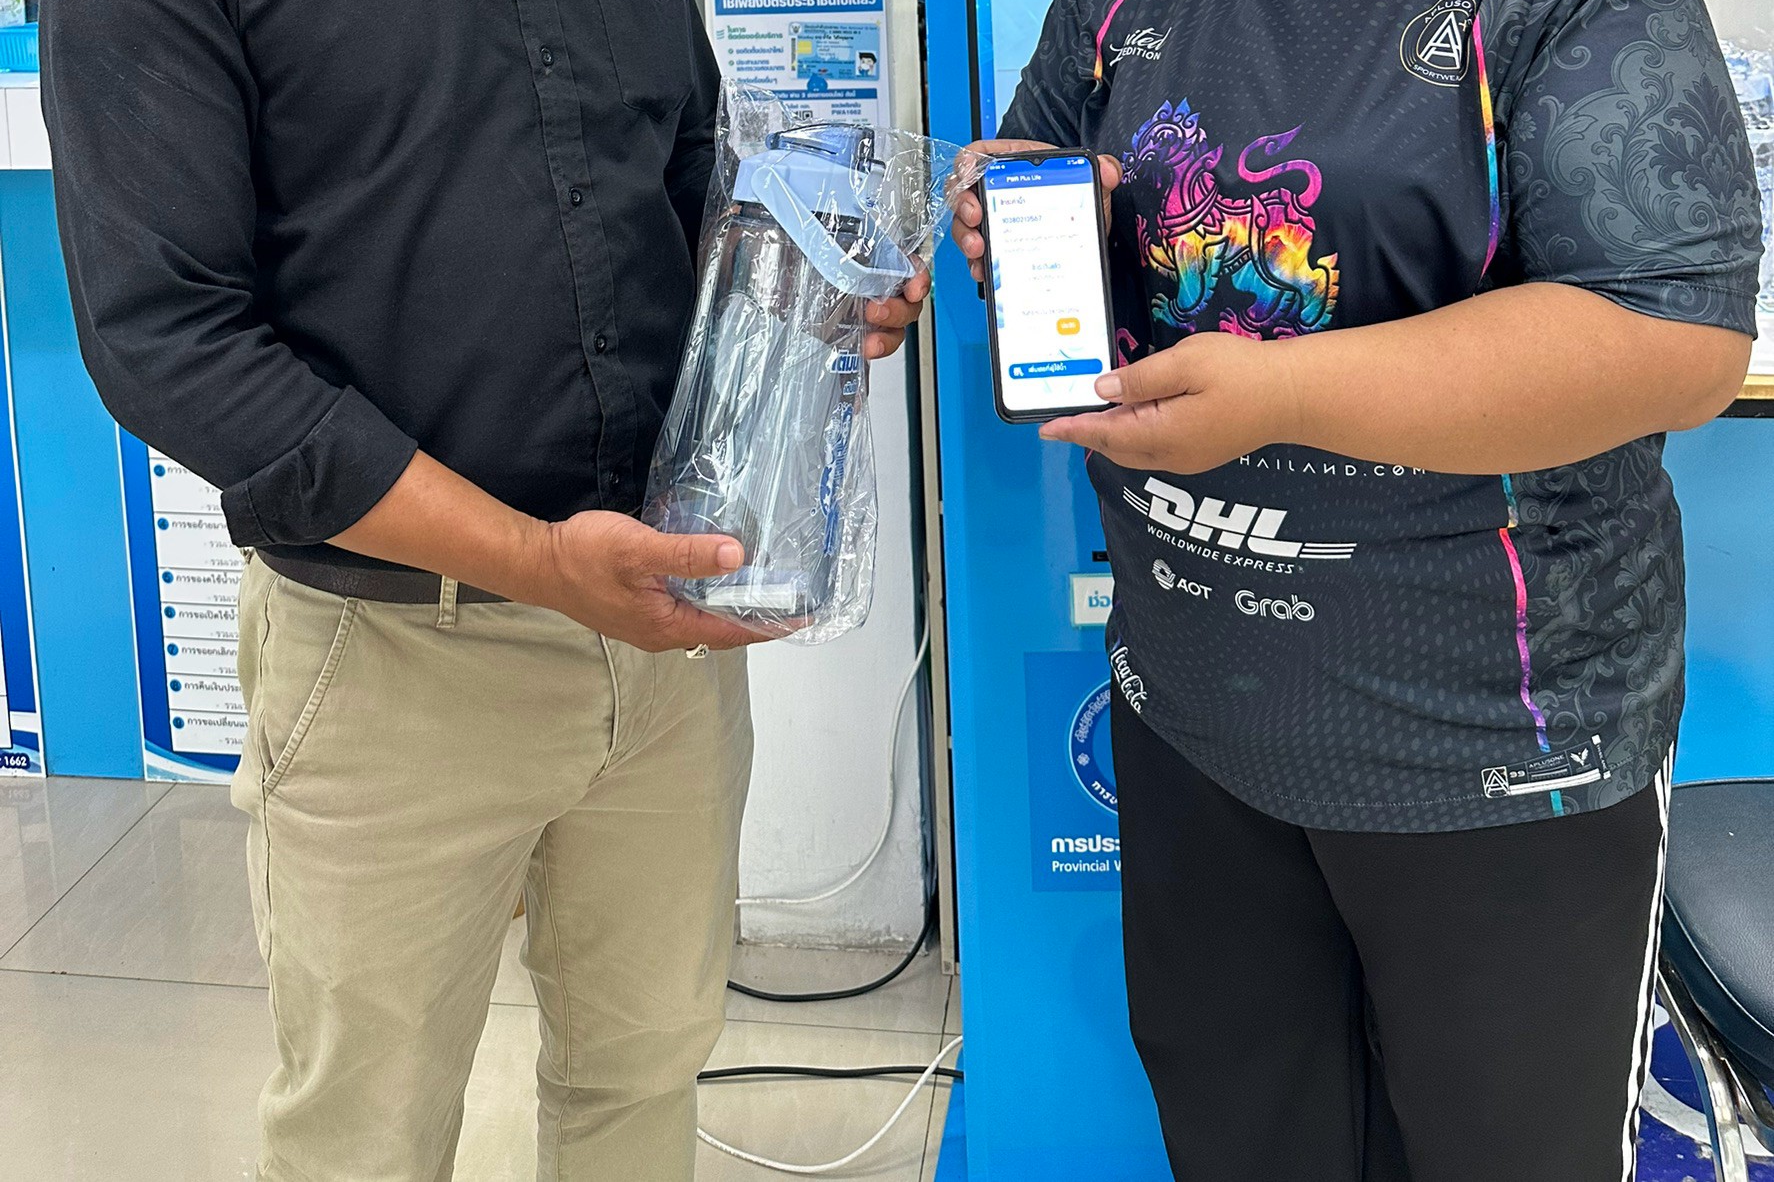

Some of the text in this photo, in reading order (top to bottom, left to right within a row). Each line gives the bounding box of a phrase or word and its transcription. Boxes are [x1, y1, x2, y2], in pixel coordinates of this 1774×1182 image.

[172, 520, 228, 530] การขอย้ายมา
[1144, 476, 1303, 558] DHL
[1147, 523, 1295, 575] WORLDWIDE EXPRESS
[1177, 577, 1212, 600] AOT
[1234, 589, 1315, 622] Grab
[184, 681, 242, 692] การคืนเงินประ
[4, 755, 27, 766] 1662
[1052, 859, 1109, 872] Provincial
